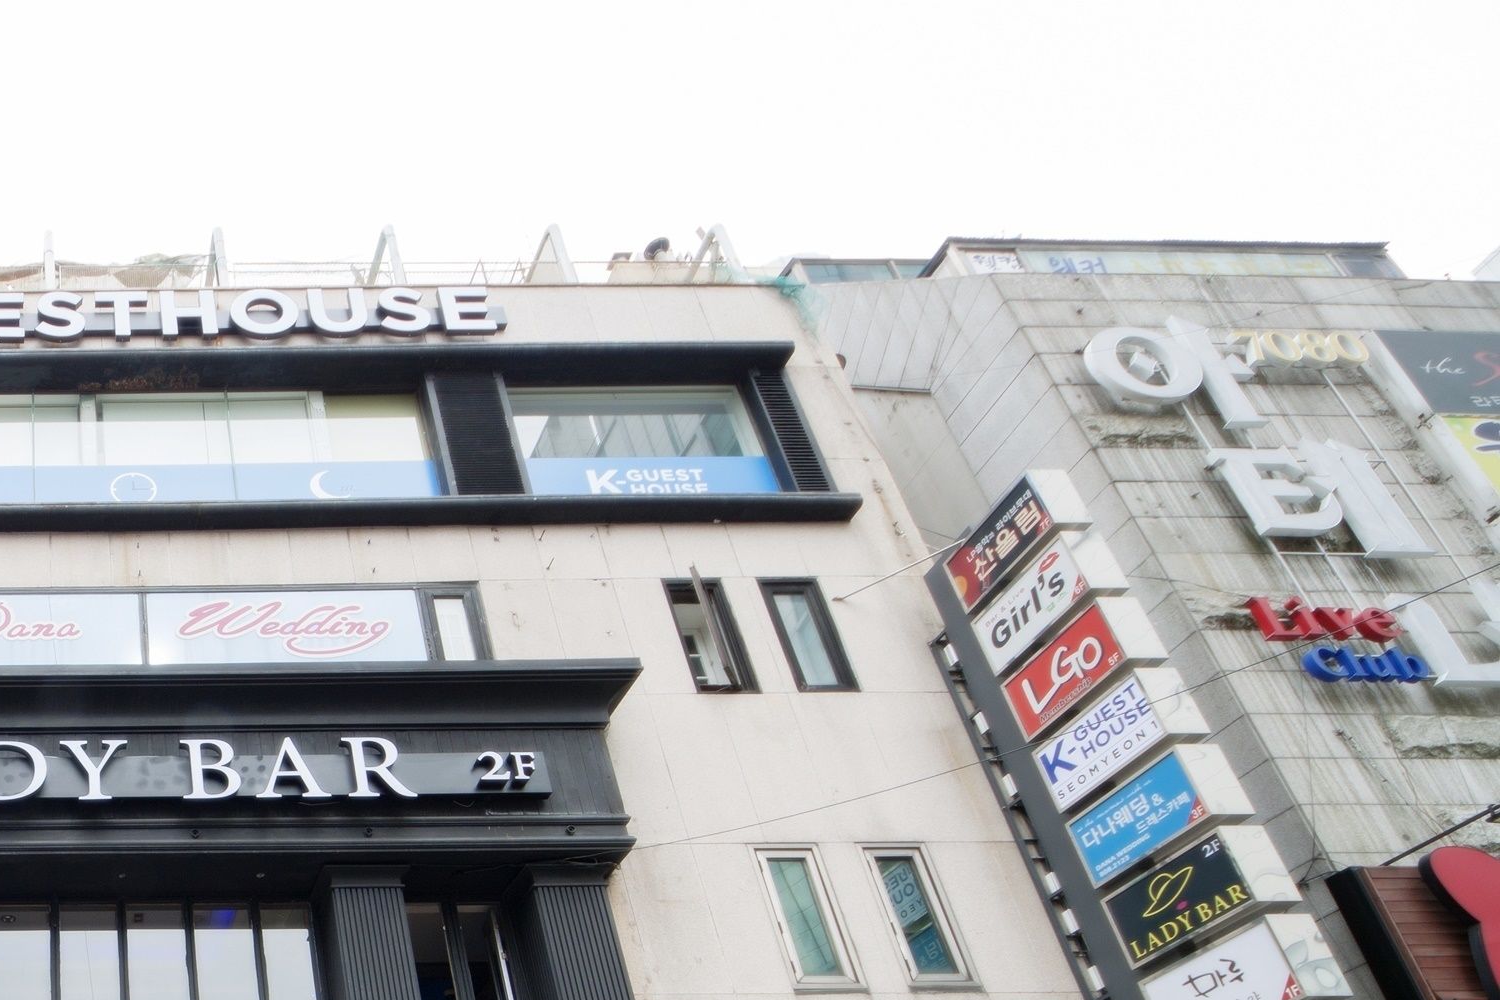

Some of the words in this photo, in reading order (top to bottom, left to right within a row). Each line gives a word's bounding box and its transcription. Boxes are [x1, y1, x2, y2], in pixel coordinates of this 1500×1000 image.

[626, 468, 703, 481] GUEST
[974, 500, 1042, 581] 산울림
[175, 601, 392, 659] Wedding
[992, 572, 1065, 648] Girl's
[1246, 596, 1400, 642] Live
[1108, 652, 1120, 666] 5F
[1302, 645, 1430, 684] Club
[1074, 683, 1137, 742] GUEST
[1081, 698, 1151, 759] HOUSE
[180, 736, 418, 801] BAR
[476, 750, 536, 785] 2F
[1058, 731, 1147, 800] SEOMYEON
[1081, 793, 1150, 849] 다나웨딩
[1191, 805, 1204, 819] 3F
[1202, 838, 1221, 859] 2F
[1130, 911, 1195, 959] LADY
[1196, 884, 1249, 922] BAR
[1285, 984, 1300, 999] 1F
